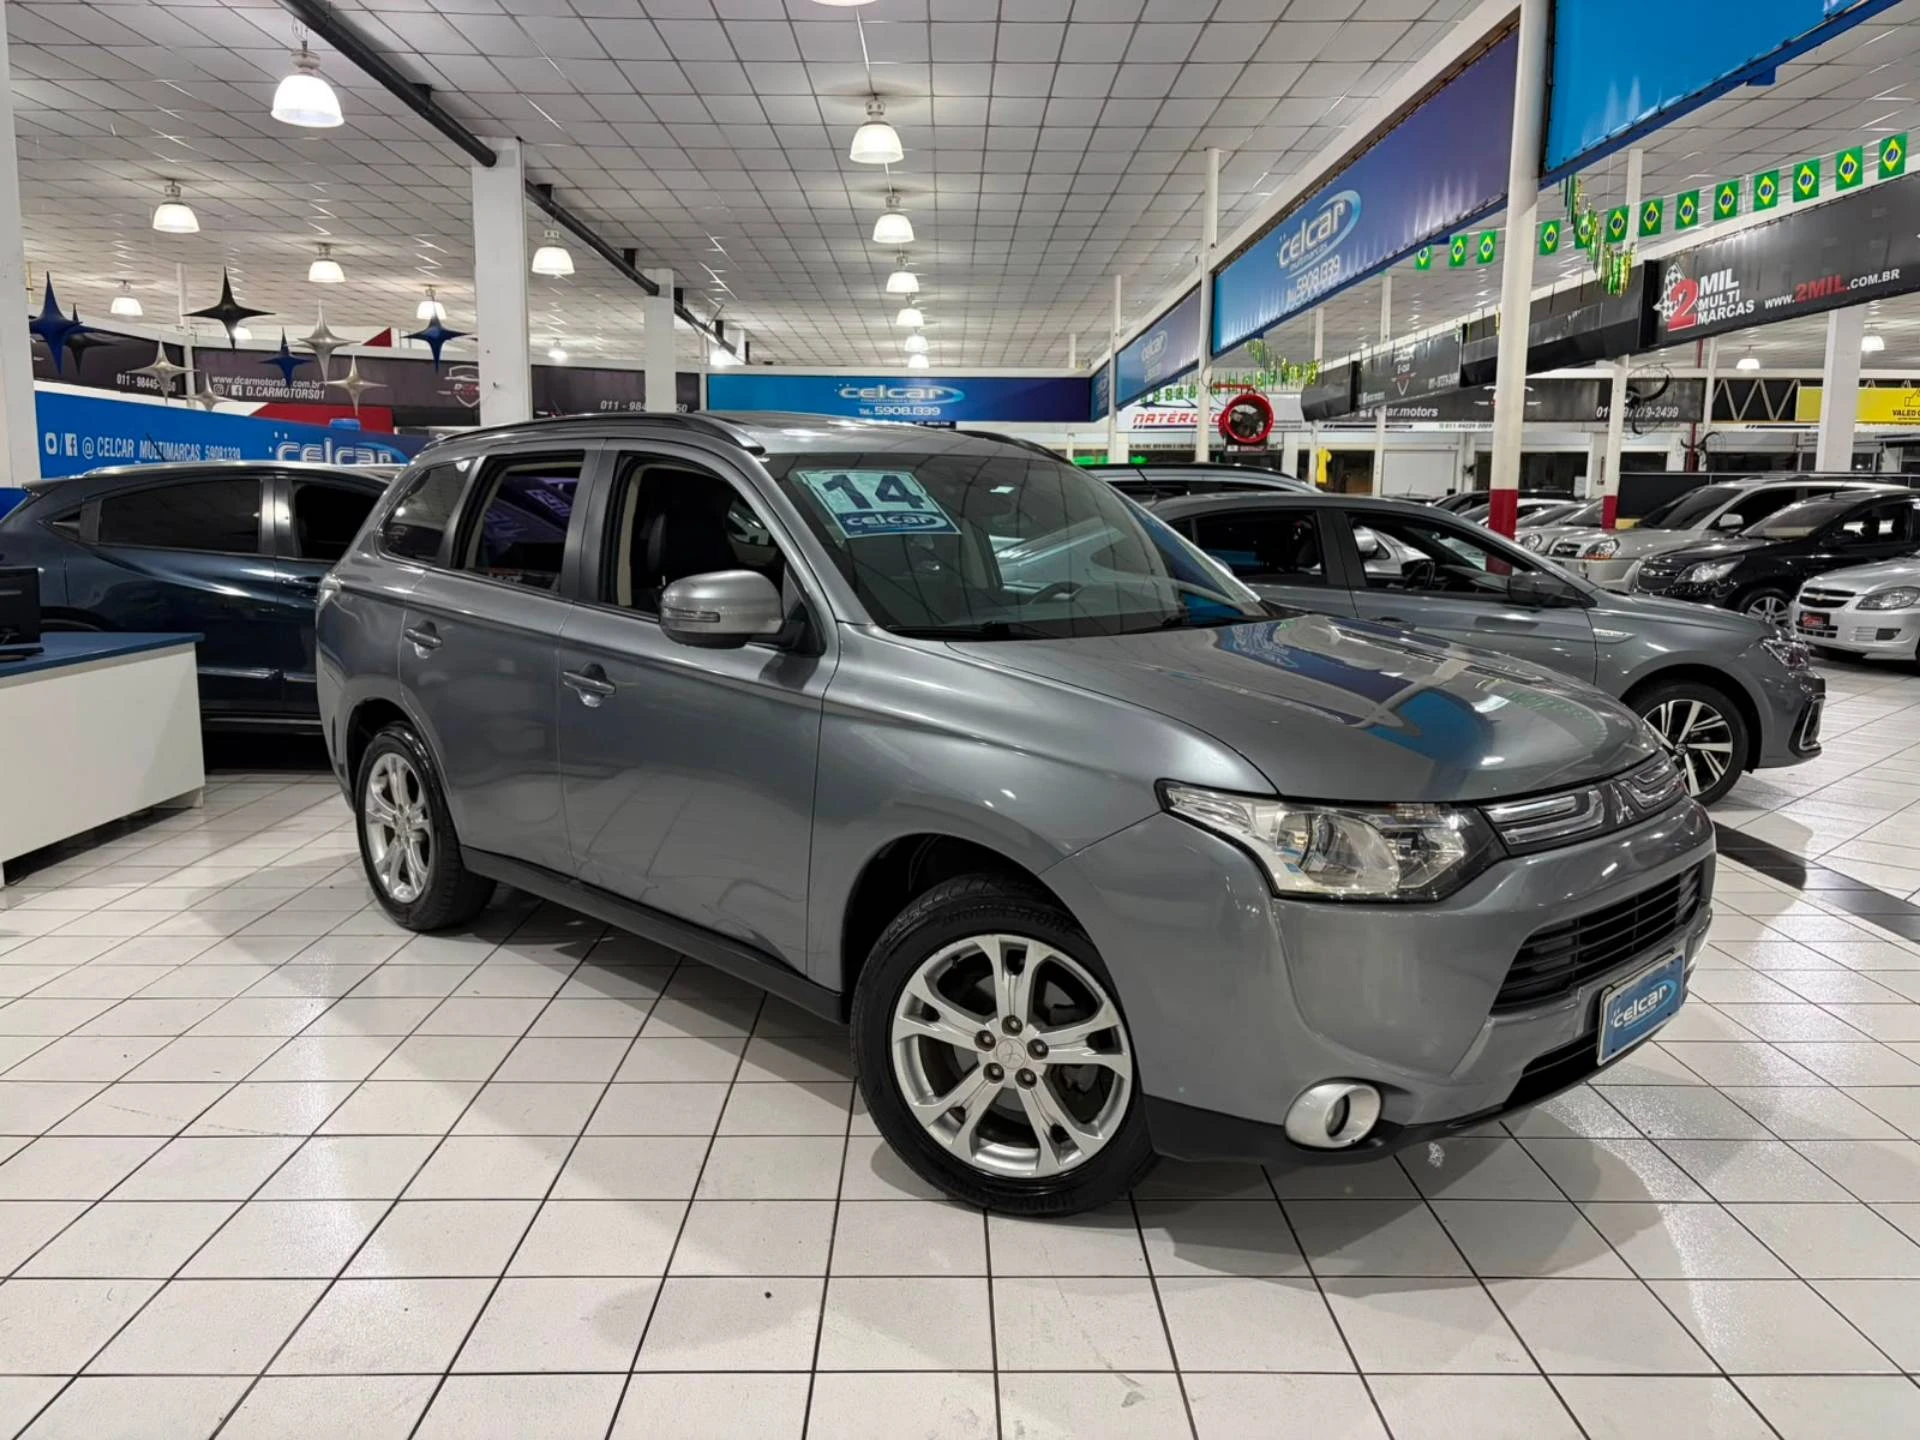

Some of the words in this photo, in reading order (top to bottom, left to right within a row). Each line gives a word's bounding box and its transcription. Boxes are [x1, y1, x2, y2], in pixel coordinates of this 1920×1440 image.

[1279, 199, 1345, 268] celcar
[1668, 278, 1699, 332] 2
[1700, 268, 1740, 297] MIL
[1699, 290, 1741, 312] MULTI
[1697, 299, 1756, 326] MARCAS
[116, 373, 131, 386] 011
[212, 375, 321, 390] www.dcarmotors0.com.br
[246, 387, 325, 400] D.CARMOTORS01
[840, 384, 945, 400] celcar
[600, 400, 619, 411] 011
[822, 474, 925, 509] 14
[846, 513, 929, 526] celcar
[1613, 984, 1668, 1029] celcar
